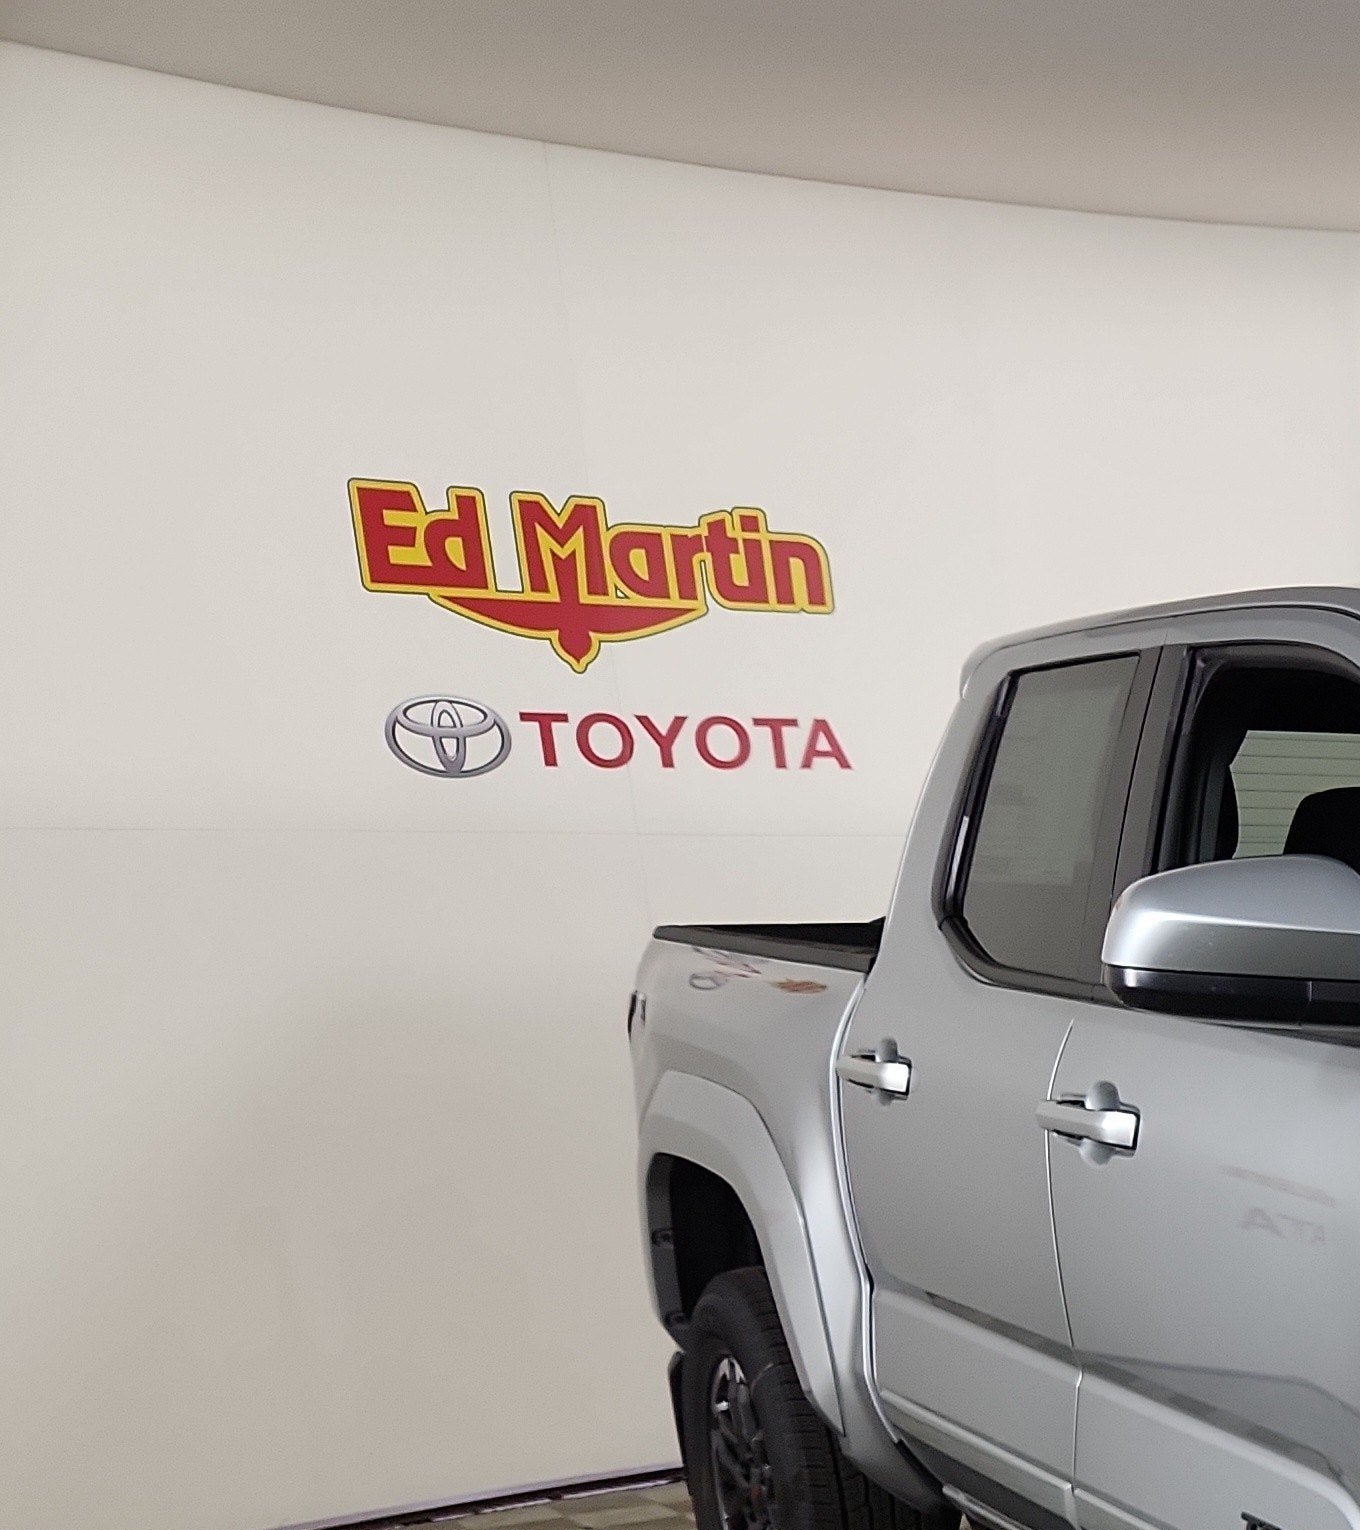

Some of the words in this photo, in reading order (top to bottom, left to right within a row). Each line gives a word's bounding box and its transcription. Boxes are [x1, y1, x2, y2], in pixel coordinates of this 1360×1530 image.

[351, 482, 492, 592] Ed
[514, 495, 831, 610] Martin
[518, 711, 853, 771] TOYOTA
